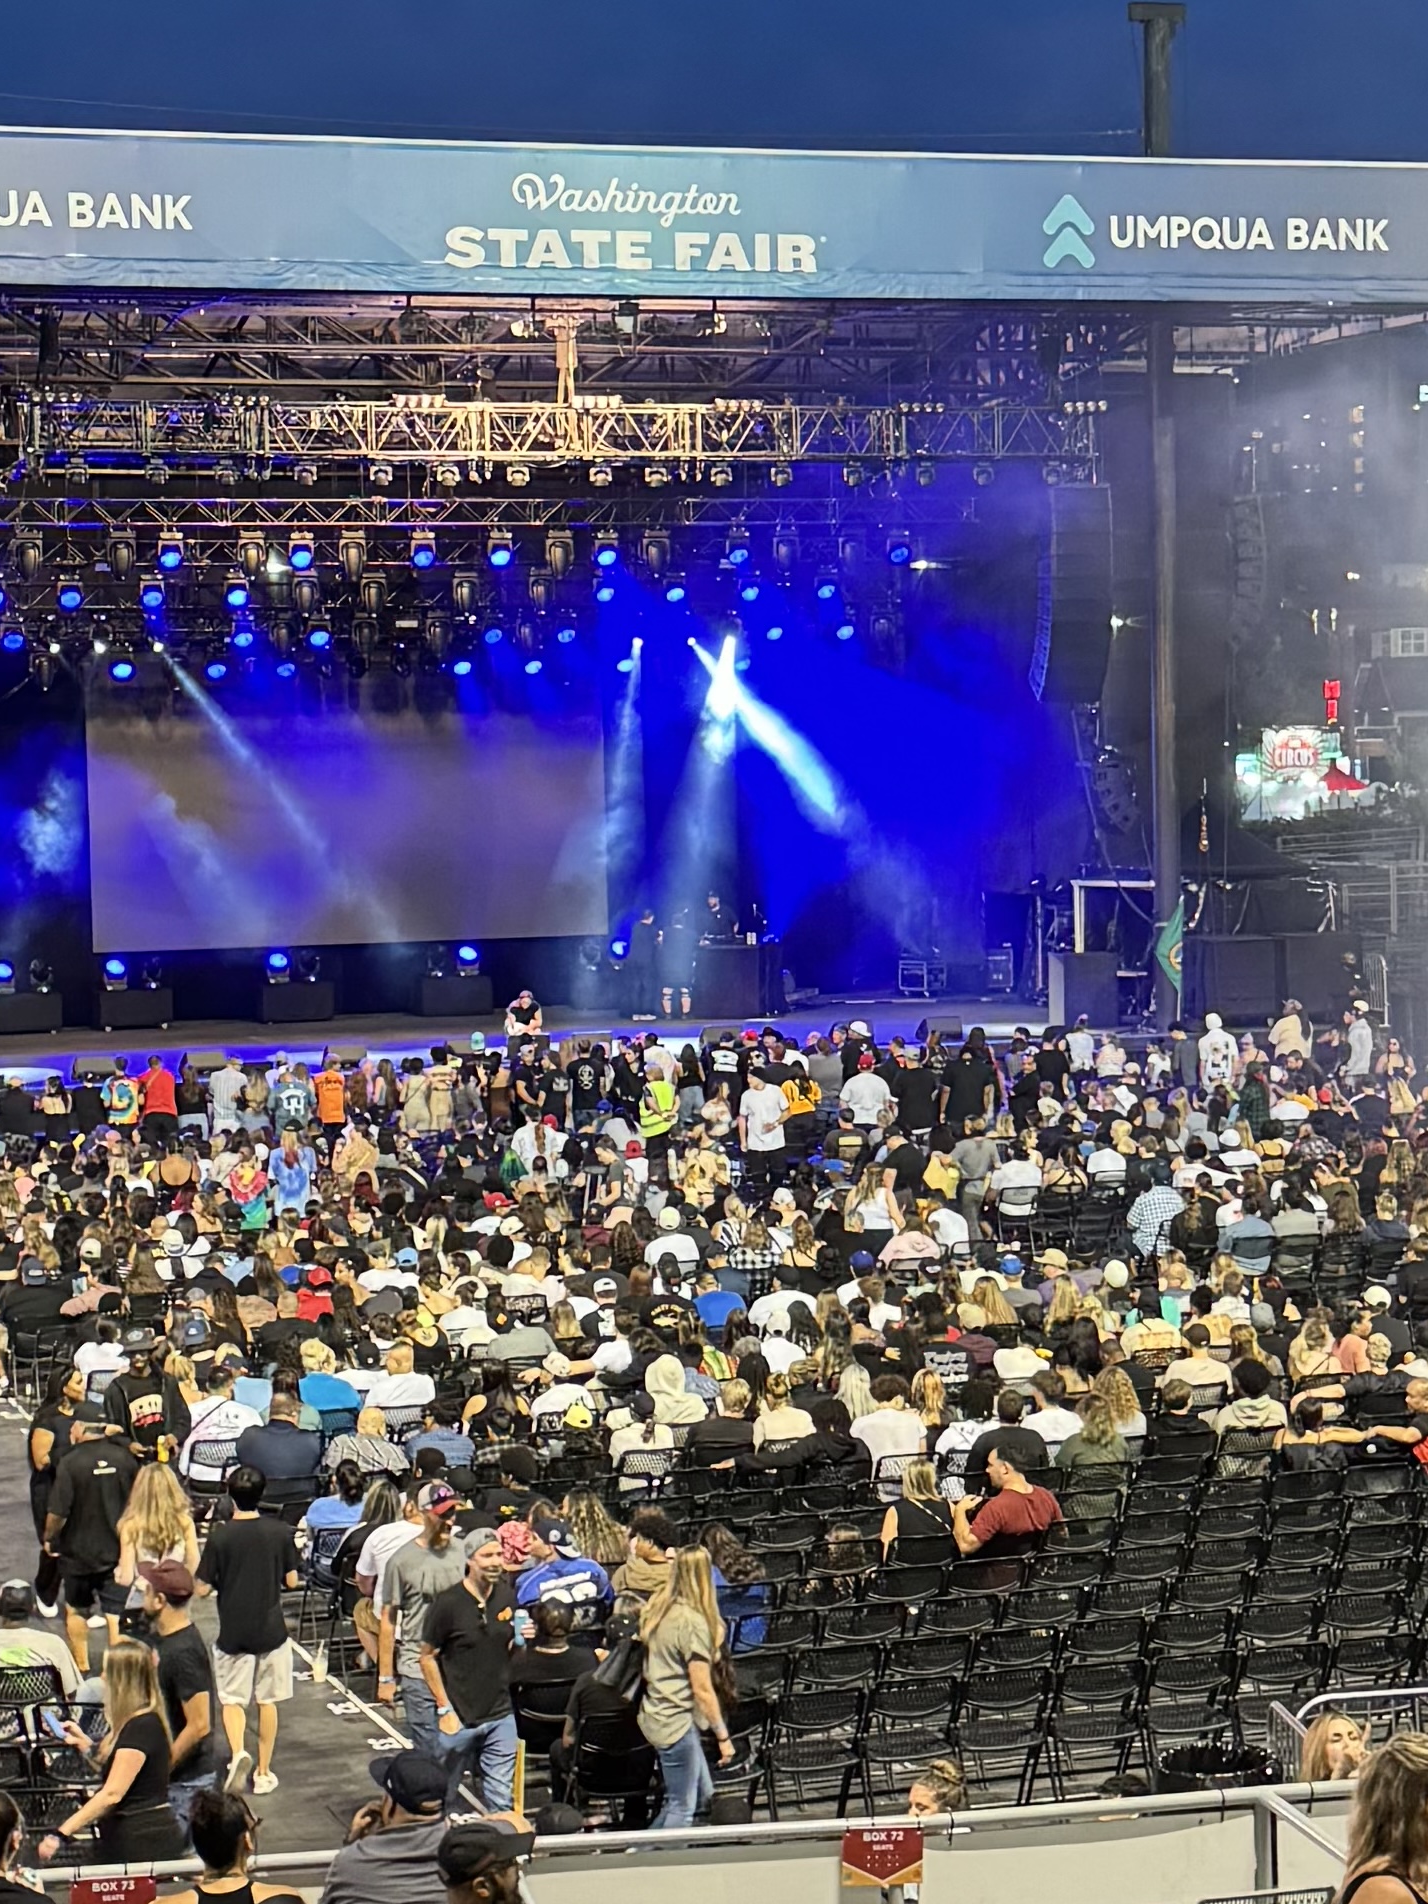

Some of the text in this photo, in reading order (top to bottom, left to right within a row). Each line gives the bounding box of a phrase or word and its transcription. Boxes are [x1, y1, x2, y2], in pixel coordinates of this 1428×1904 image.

[67, 191, 193, 231] BANK
[511, 172, 741, 227] Washington
[444, 225, 818, 273] STATE FAIR
[1109, 214, 1390, 252] UMPQUA BANK
[1273, 748, 1316, 767] CIRCUS
[862, 1830, 904, 1842] BOX 72
[92, 1880, 135, 1893] BOX 73
